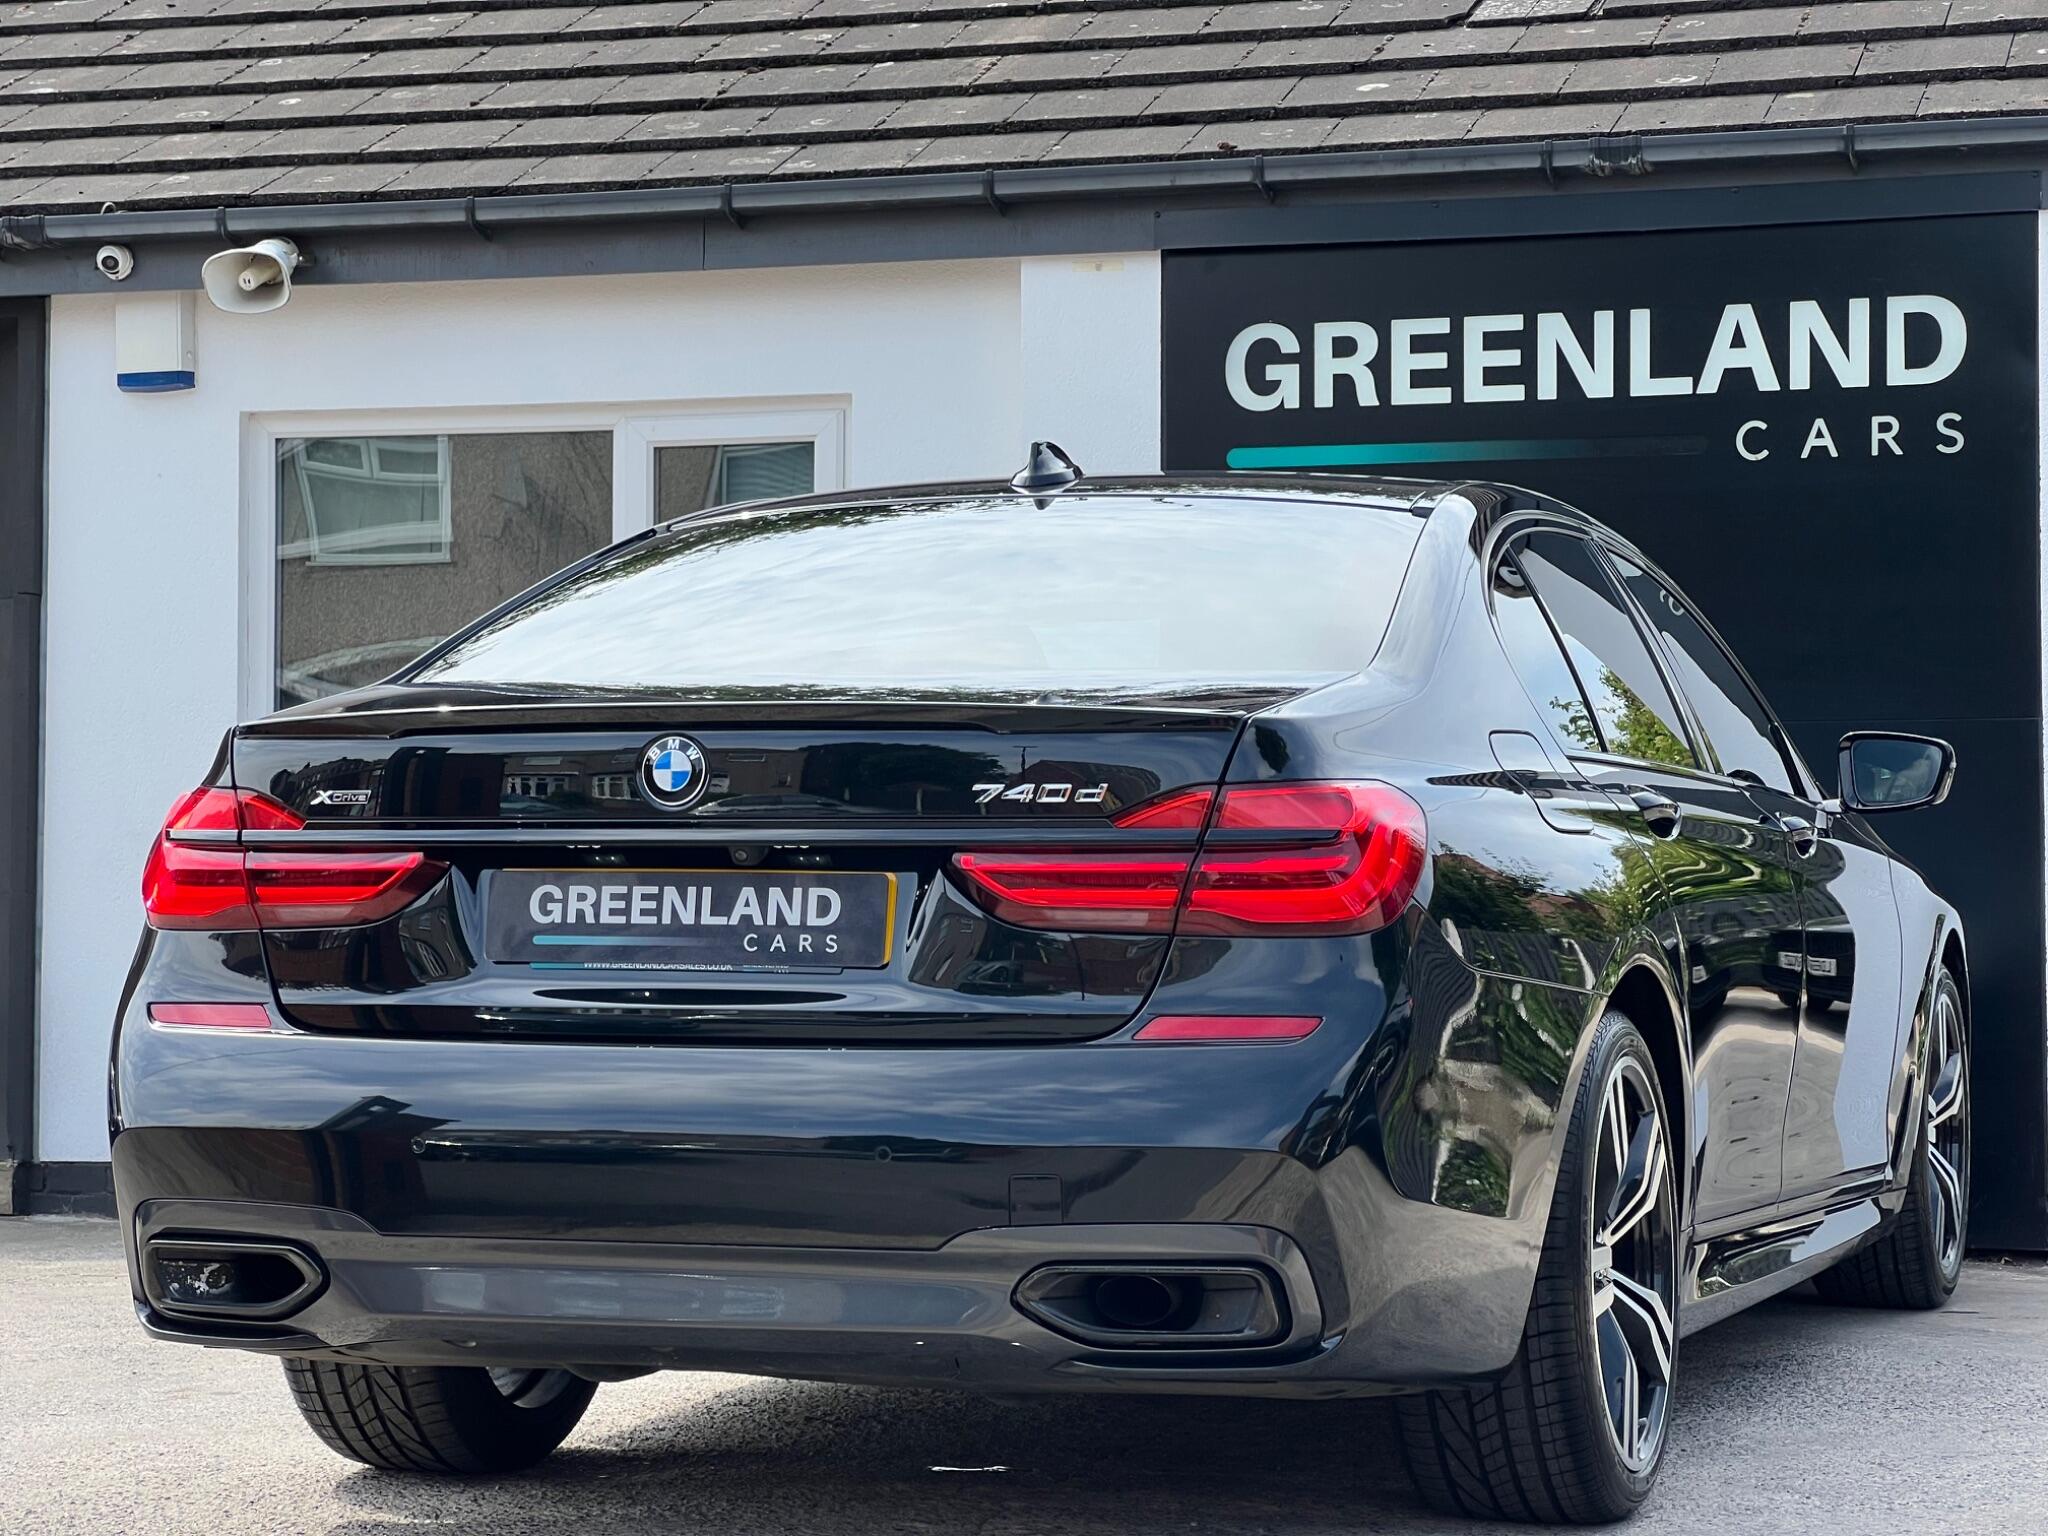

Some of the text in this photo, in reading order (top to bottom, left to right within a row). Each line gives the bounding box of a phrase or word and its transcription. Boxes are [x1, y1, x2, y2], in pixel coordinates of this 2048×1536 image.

[1225, 295, 1967, 412] GREENLAND
[1735, 412, 1965, 461] CARS
[648, 739, 700, 760] BMW
[972, 783, 1108, 803] 740d
[529, 884, 842, 926] GREENLAND
[743, 933, 838, 953] CARS
